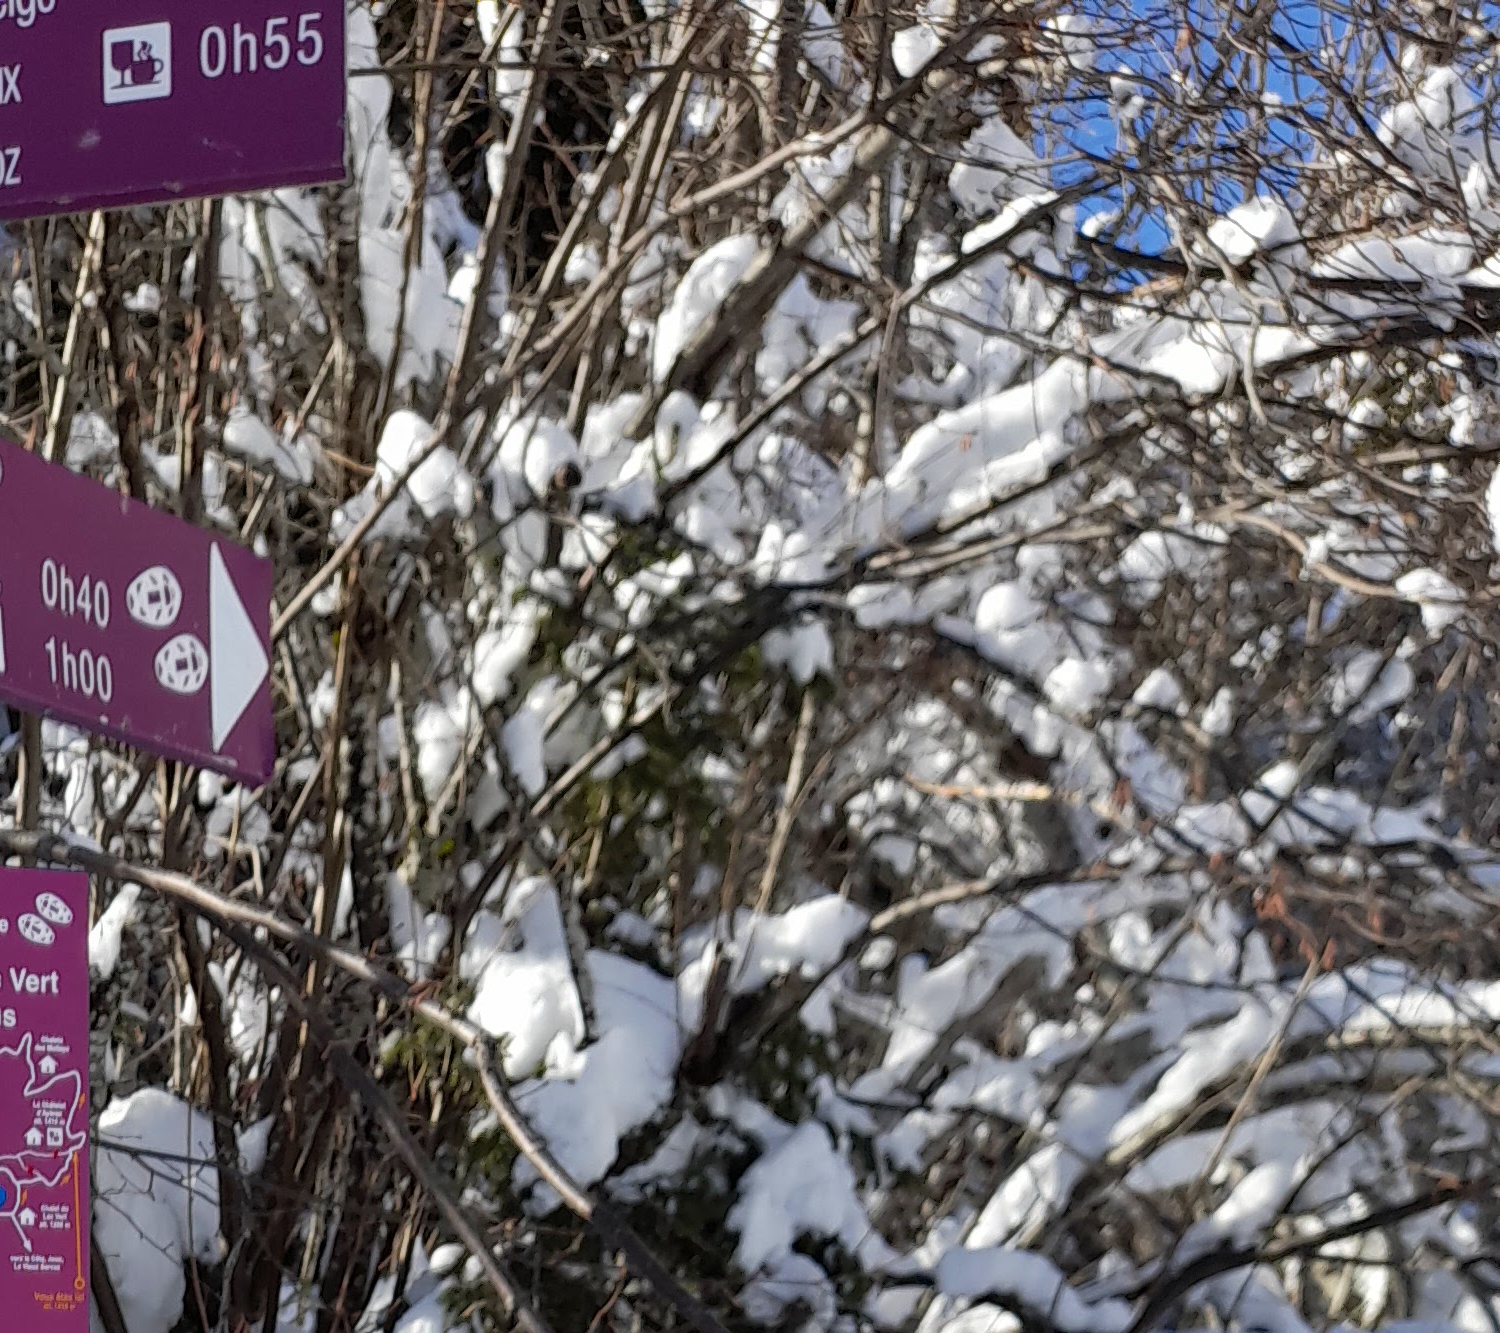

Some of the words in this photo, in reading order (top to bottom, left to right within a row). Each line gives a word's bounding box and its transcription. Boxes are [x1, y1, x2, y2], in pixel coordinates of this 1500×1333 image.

[201, 14, 322, 78] 0h55
[42, 559, 109, 628] 0h40
[46, 637, 111, 702] 1h00
[10, 968, 58, 994] Vert
